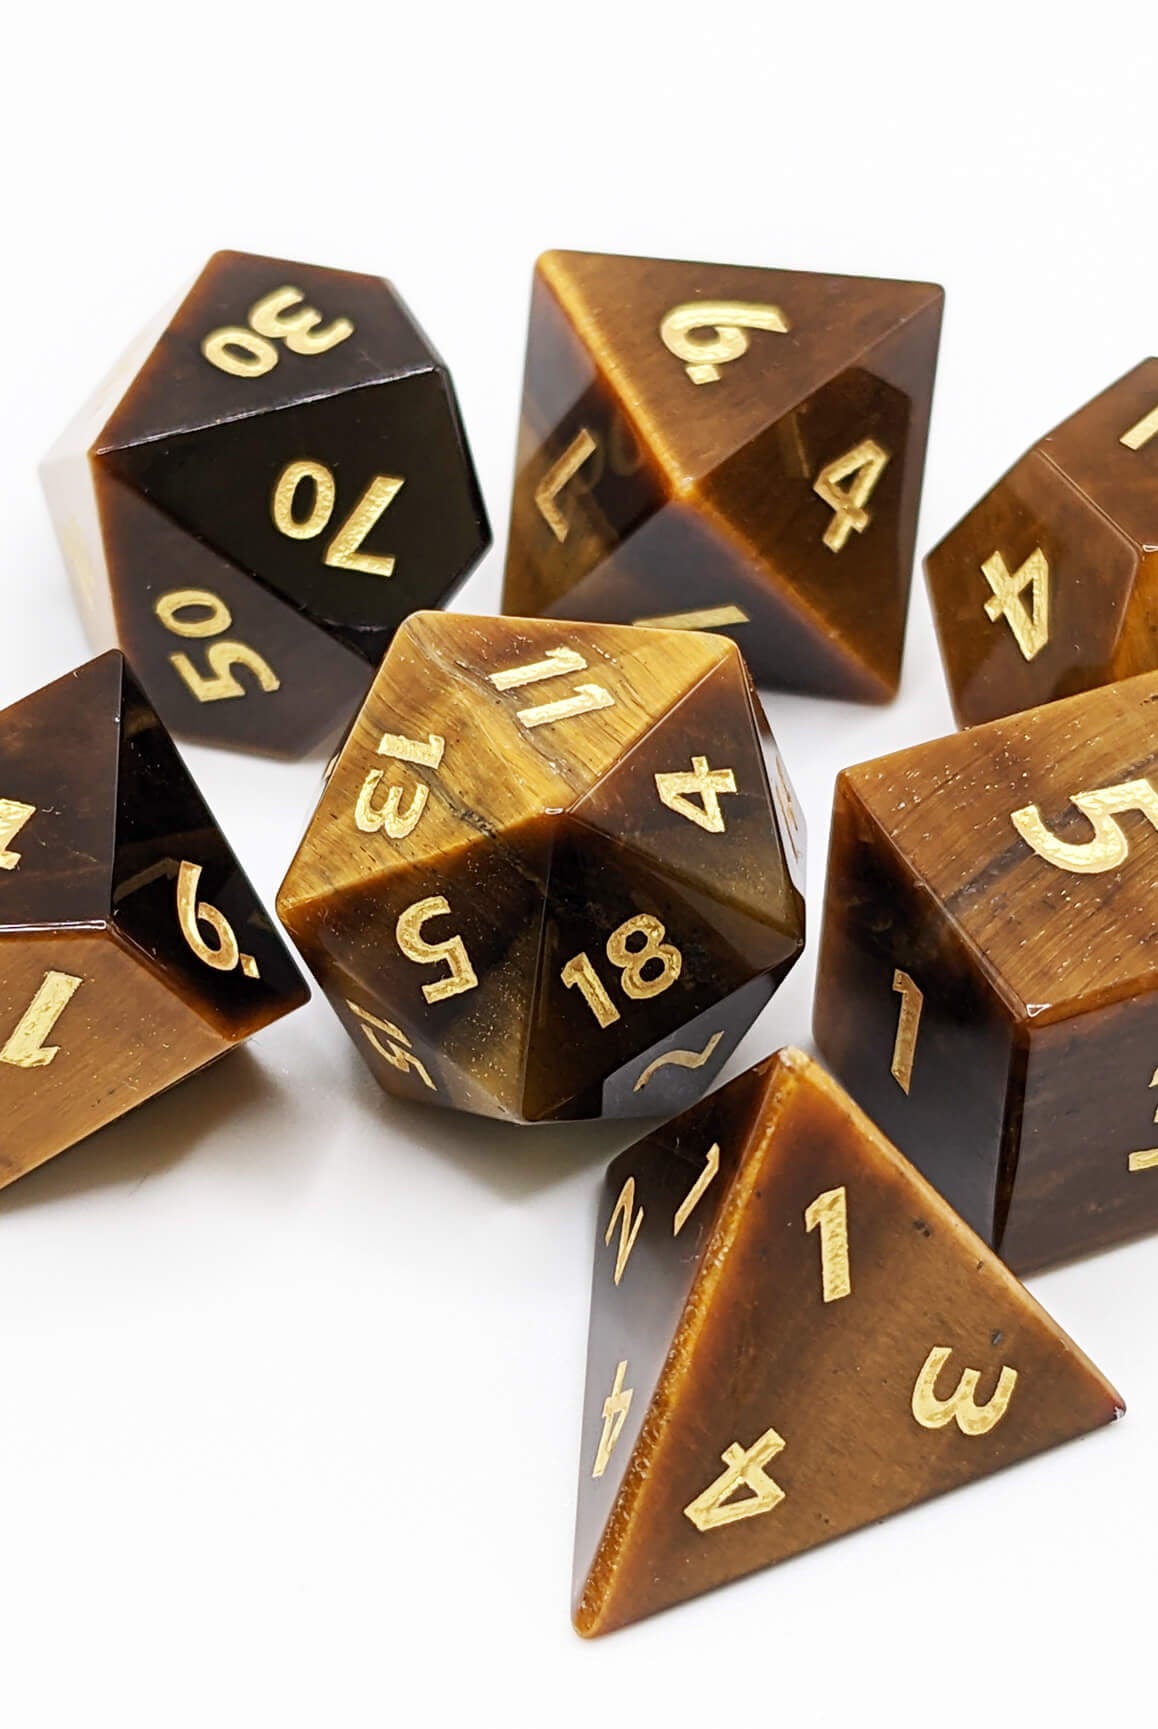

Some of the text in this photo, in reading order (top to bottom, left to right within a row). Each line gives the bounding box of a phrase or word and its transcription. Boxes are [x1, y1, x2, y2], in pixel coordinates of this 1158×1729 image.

[204, 286, 353, 377] 30
[273, 461, 404, 577] 70
[813, 440, 890, 553] 4
[156, 590, 279, 702] 50
[981, 548, 1049, 662] 4
[488, 647, 614, 728] 11
[354, 732, 445, 838] 13
[655, 756, 737, 833] 4
[1010, 778, 1158, 873] 5
[396, 896, 478, 1004] 5
[561, 914, 682, 1028] 18
[0, 971, 82, 1068] 1
[346, 999, 437, 1091] 15
[891, 968, 923, 1096] 1
[674, 1143, 719, 1236] 1
[805, 1186, 850, 1302] 1
[592, 1361, 632, 1478] 4
[912, 1346, 1017, 1435] 3
[684, 1428, 786, 1532] 4
